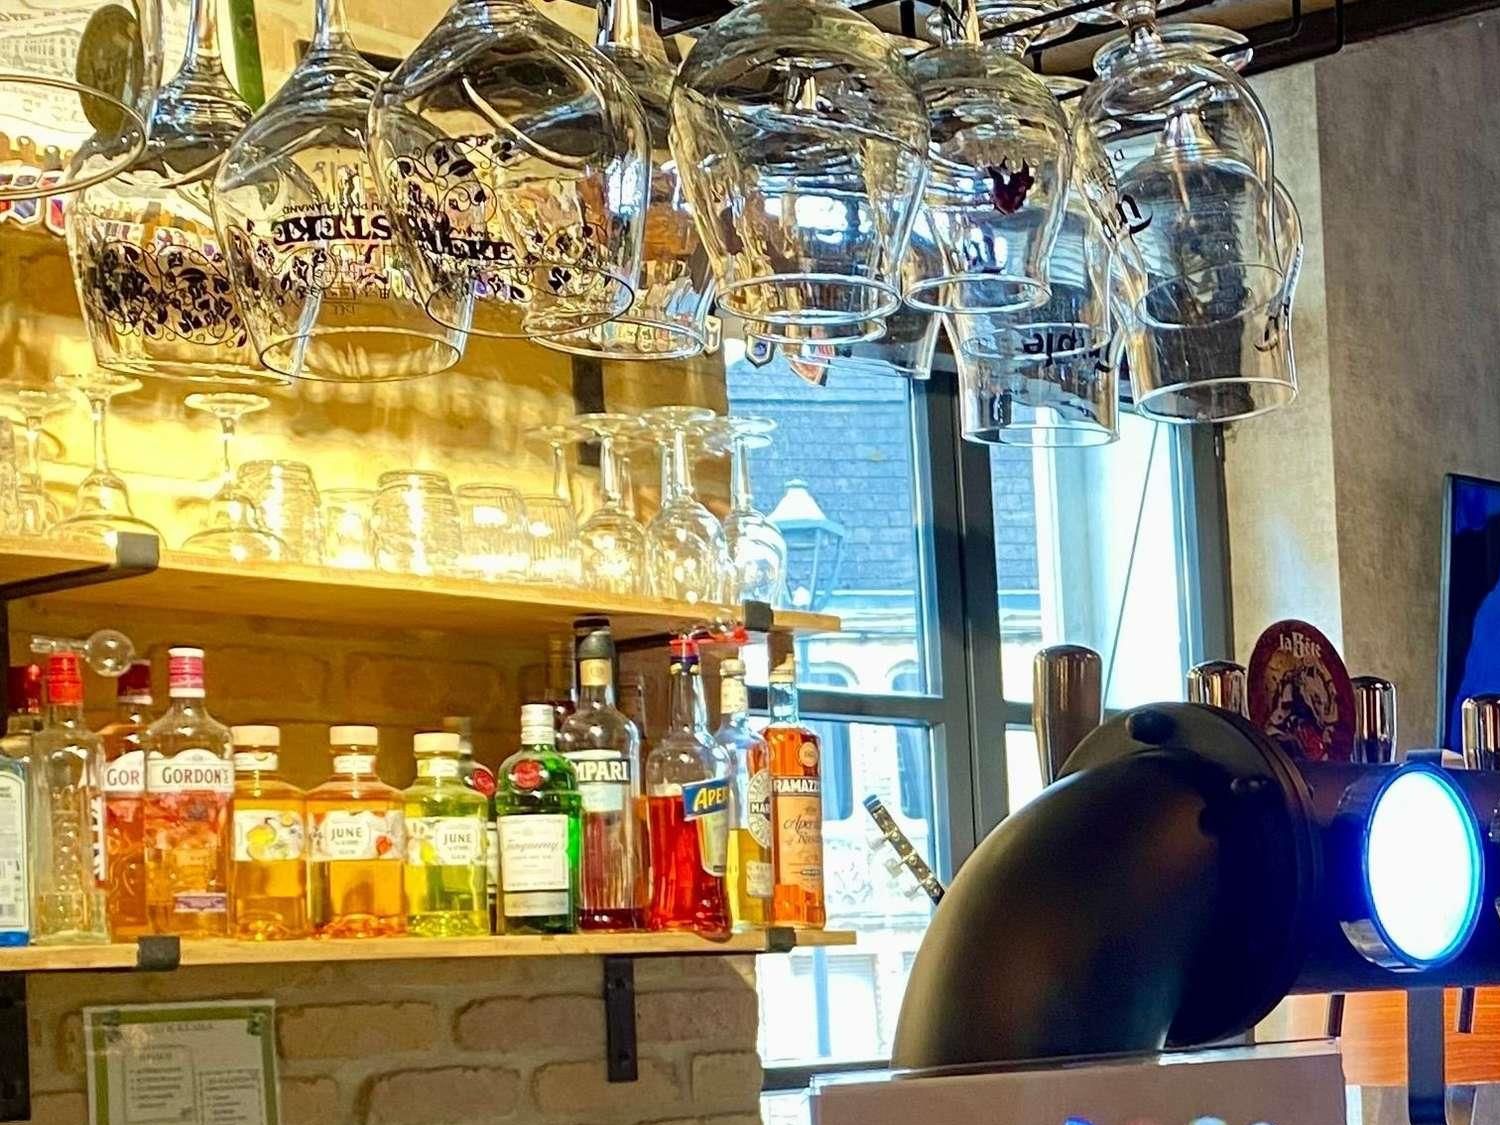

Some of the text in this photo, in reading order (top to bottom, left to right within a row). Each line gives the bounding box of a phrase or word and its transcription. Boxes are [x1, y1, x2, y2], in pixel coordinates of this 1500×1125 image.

[575, 760, 630, 782] MPARI
[773, 779, 819, 793] RAMAZZ
[692, 786, 729, 812] APER
[330, 826, 364, 840] JUNE
[443, 832, 473, 844] JUNE
